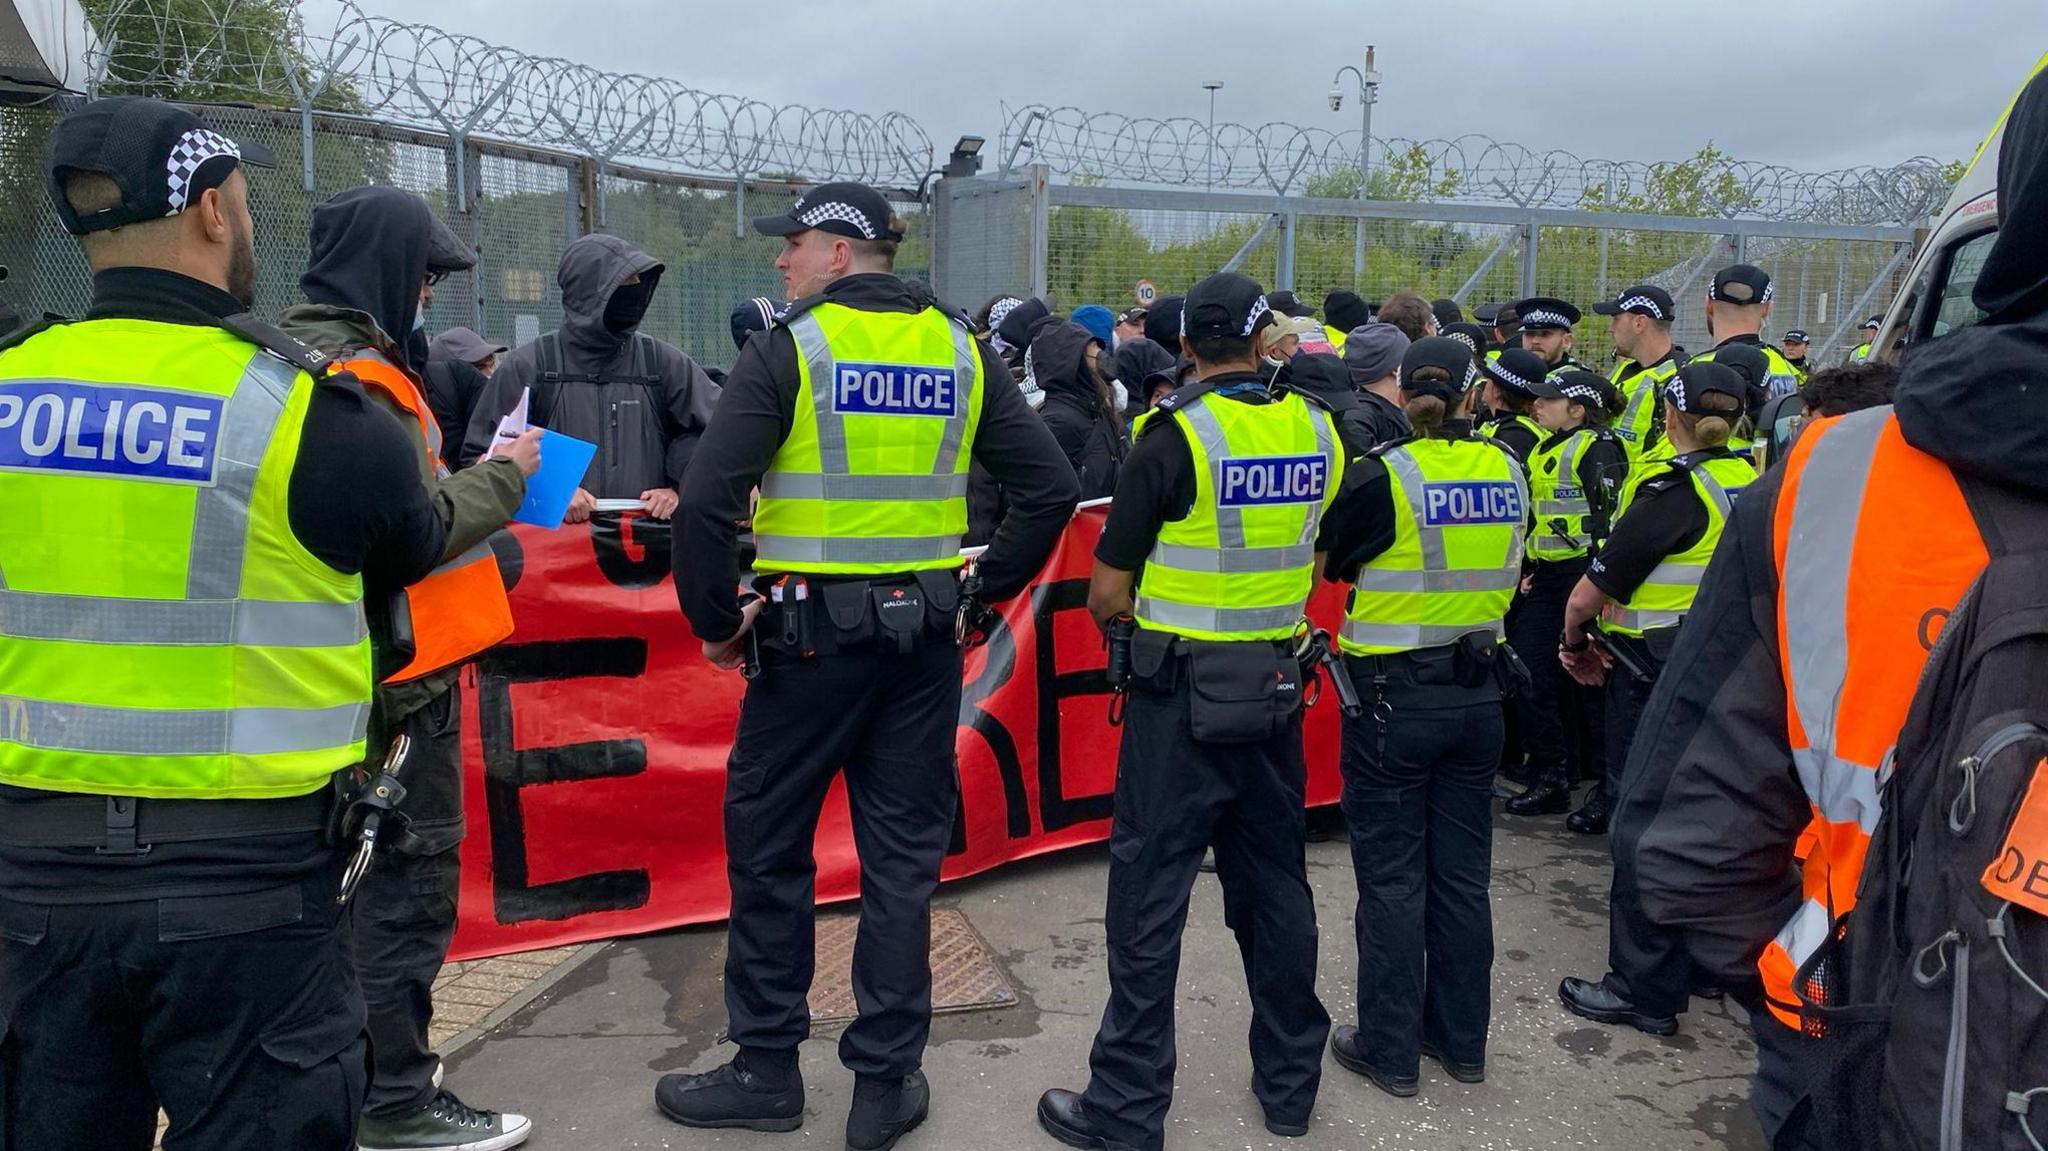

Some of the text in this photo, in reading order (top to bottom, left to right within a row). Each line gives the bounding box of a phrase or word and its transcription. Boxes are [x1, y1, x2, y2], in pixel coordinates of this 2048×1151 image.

[1140, 287, 1154, 299] 10
[840, 369, 951, 409] POLICE
[1225, 462, 1324, 499] POLICE
[1555, 488, 1581, 498] POLICE
[1427, 487, 1520, 519] POLICE
